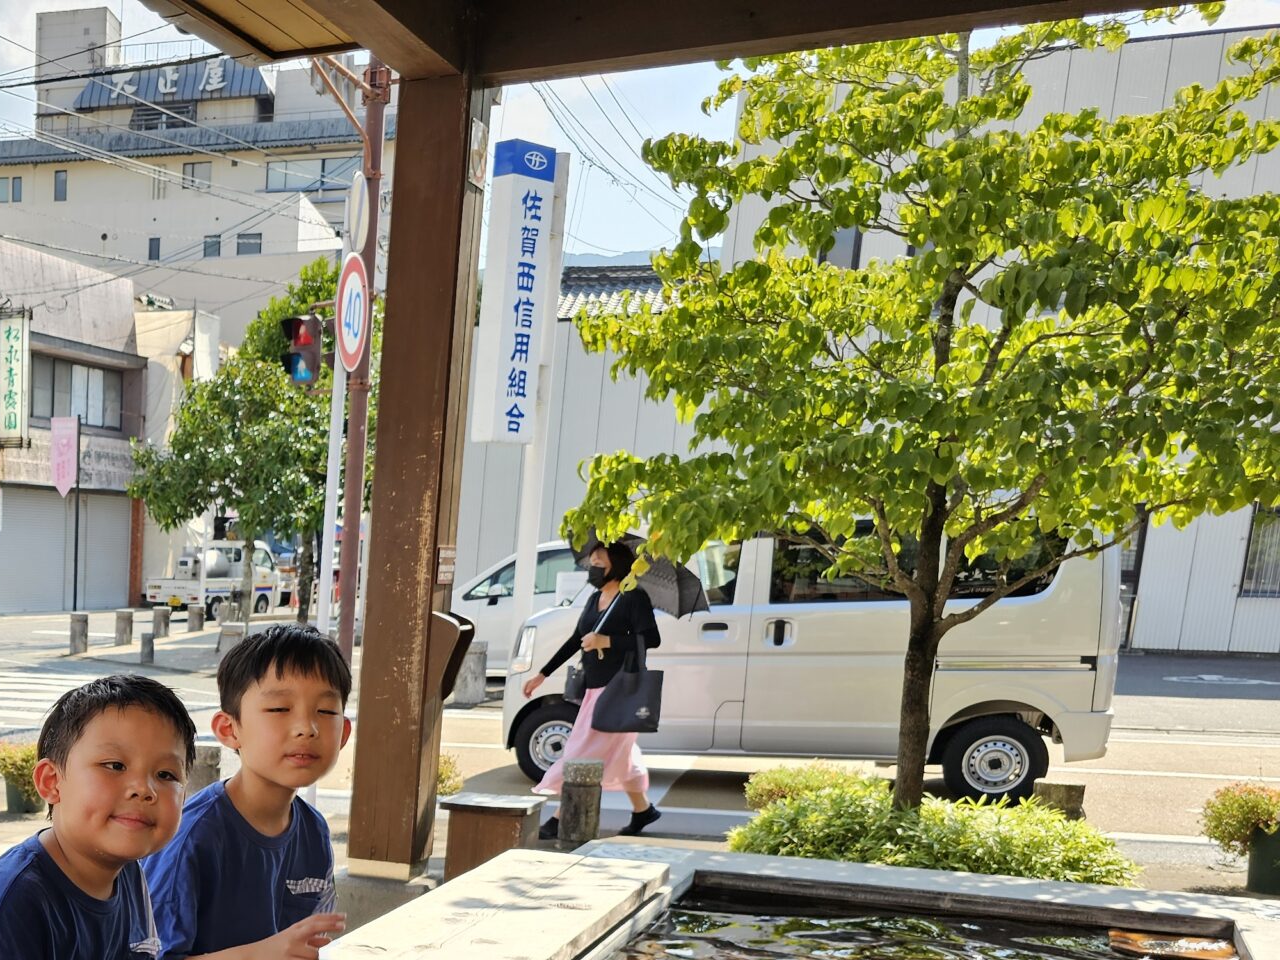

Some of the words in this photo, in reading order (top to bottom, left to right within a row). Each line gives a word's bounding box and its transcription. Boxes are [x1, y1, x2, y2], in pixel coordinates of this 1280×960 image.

[344, 287, 362, 339] 40
[505, 188, 544, 434] 佐賀西信用組合
